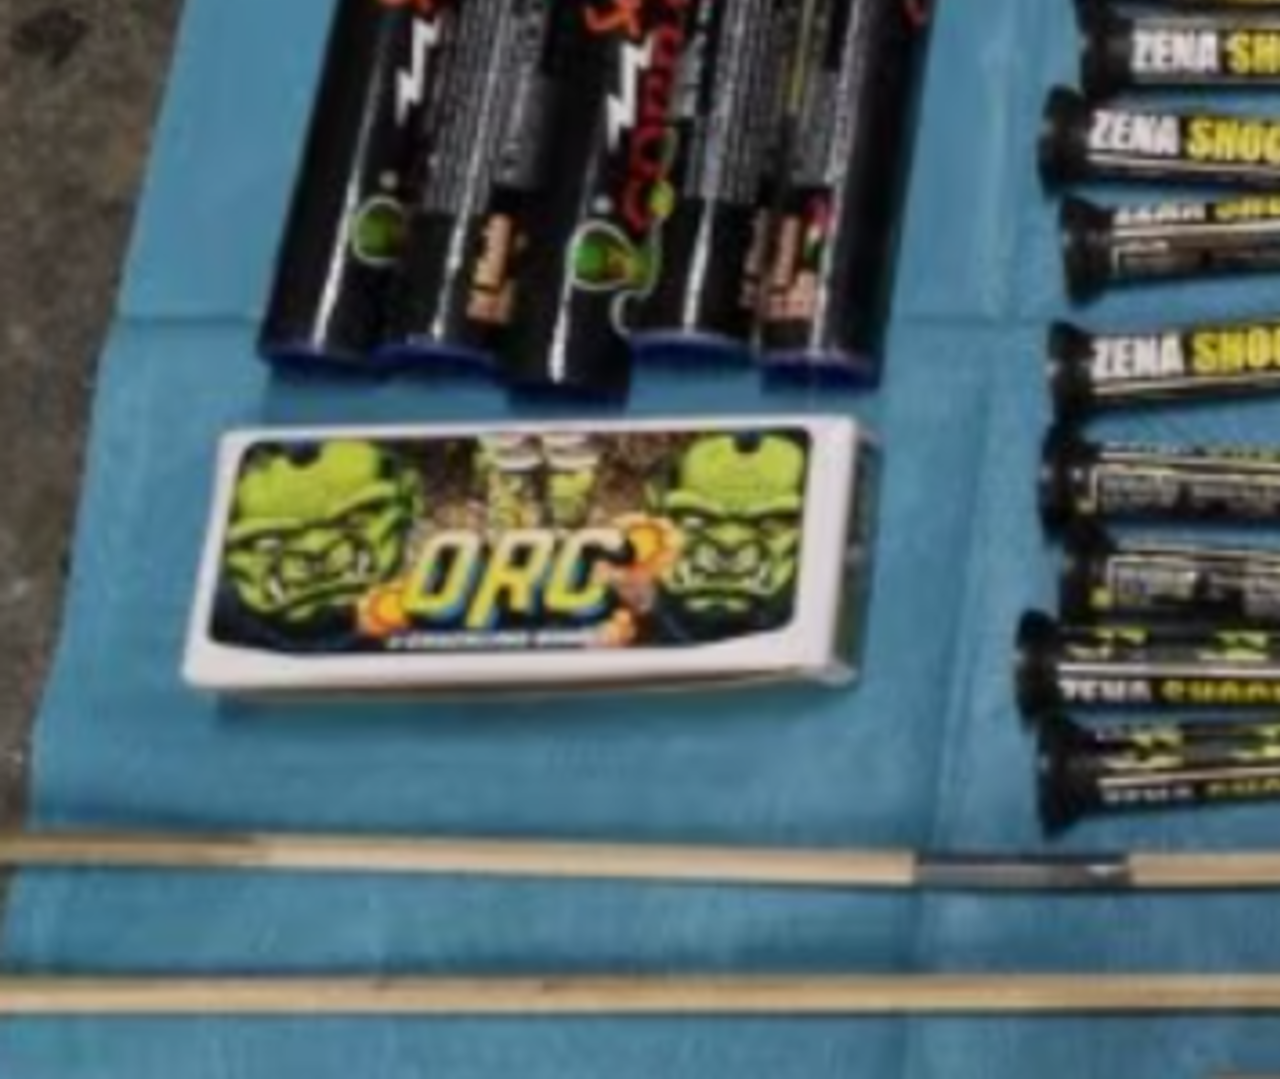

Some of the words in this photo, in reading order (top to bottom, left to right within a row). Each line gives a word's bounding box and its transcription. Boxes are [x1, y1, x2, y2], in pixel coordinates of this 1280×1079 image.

[1131, 32, 1218, 74] ZENA
[1089, 111, 1179, 156] ZENA
[1090, 332, 1184, 381] ZENA
[402, 527, 625, 628] ORC
